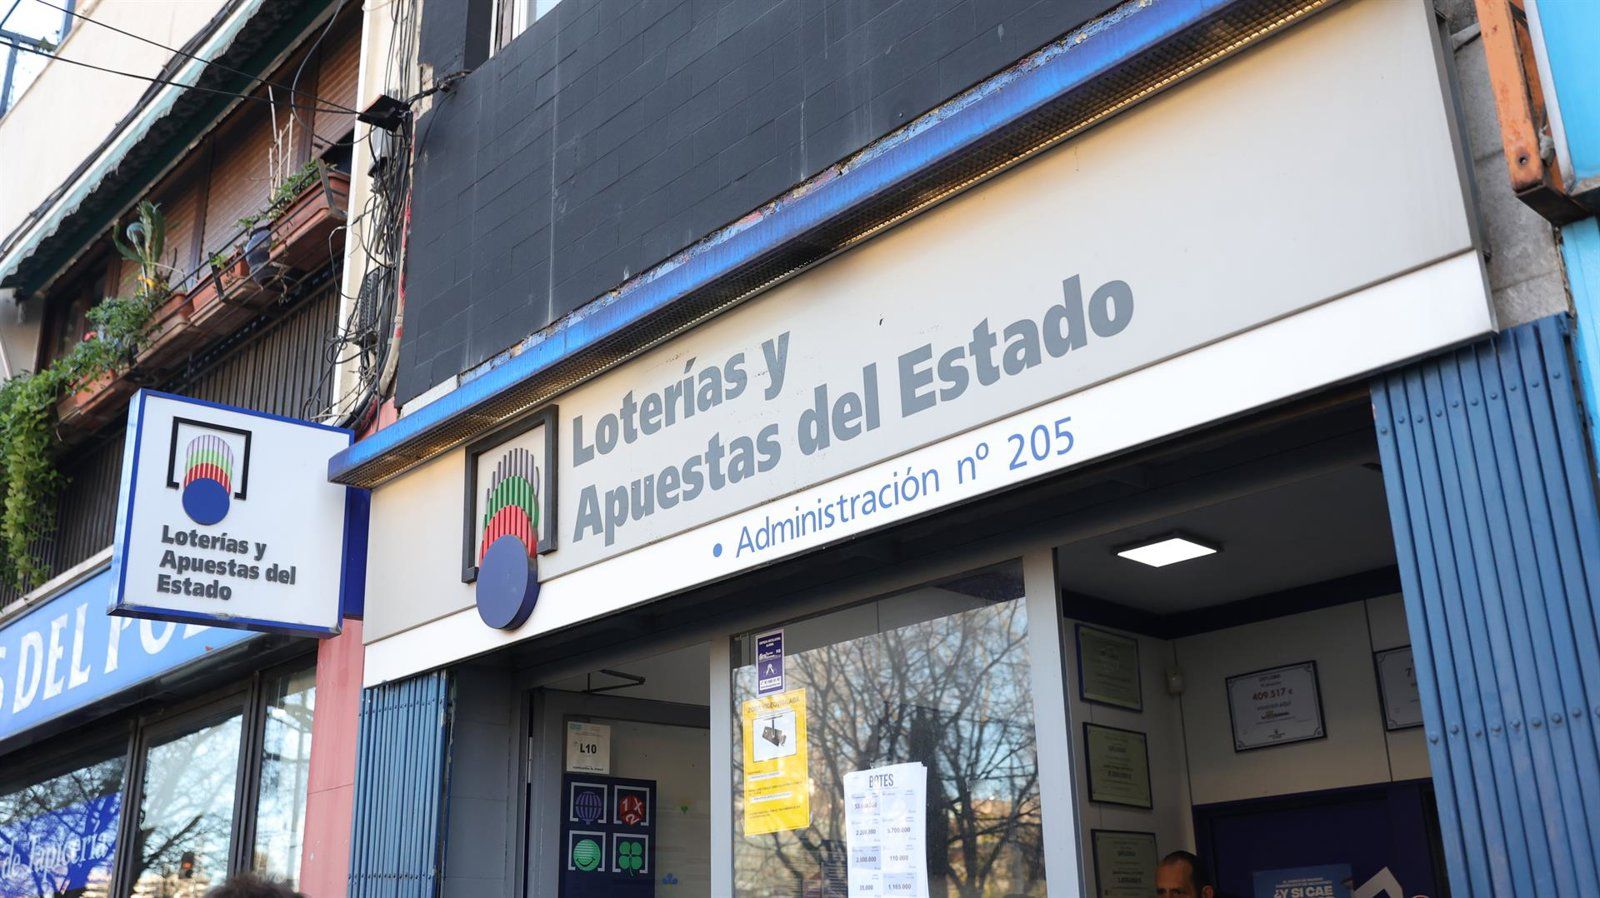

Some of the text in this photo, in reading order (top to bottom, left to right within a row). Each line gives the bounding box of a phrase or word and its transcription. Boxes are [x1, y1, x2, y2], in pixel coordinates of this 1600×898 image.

[572, 331, 790, 467] Loterías y
[572, 273, 1134, 547] Apuestas del Estado
[735, 416, 1075, 558] Administración nº 205
[161, 525, 267, 561] Loterías y
[159, 550, 296, 586] Apuestas del
[156, 574, 232, 601] Estado
[12, 602, 91, 714] DEL
[580, 743, 597, 754] L10
[1305, 885, 1333, 897] CAE
